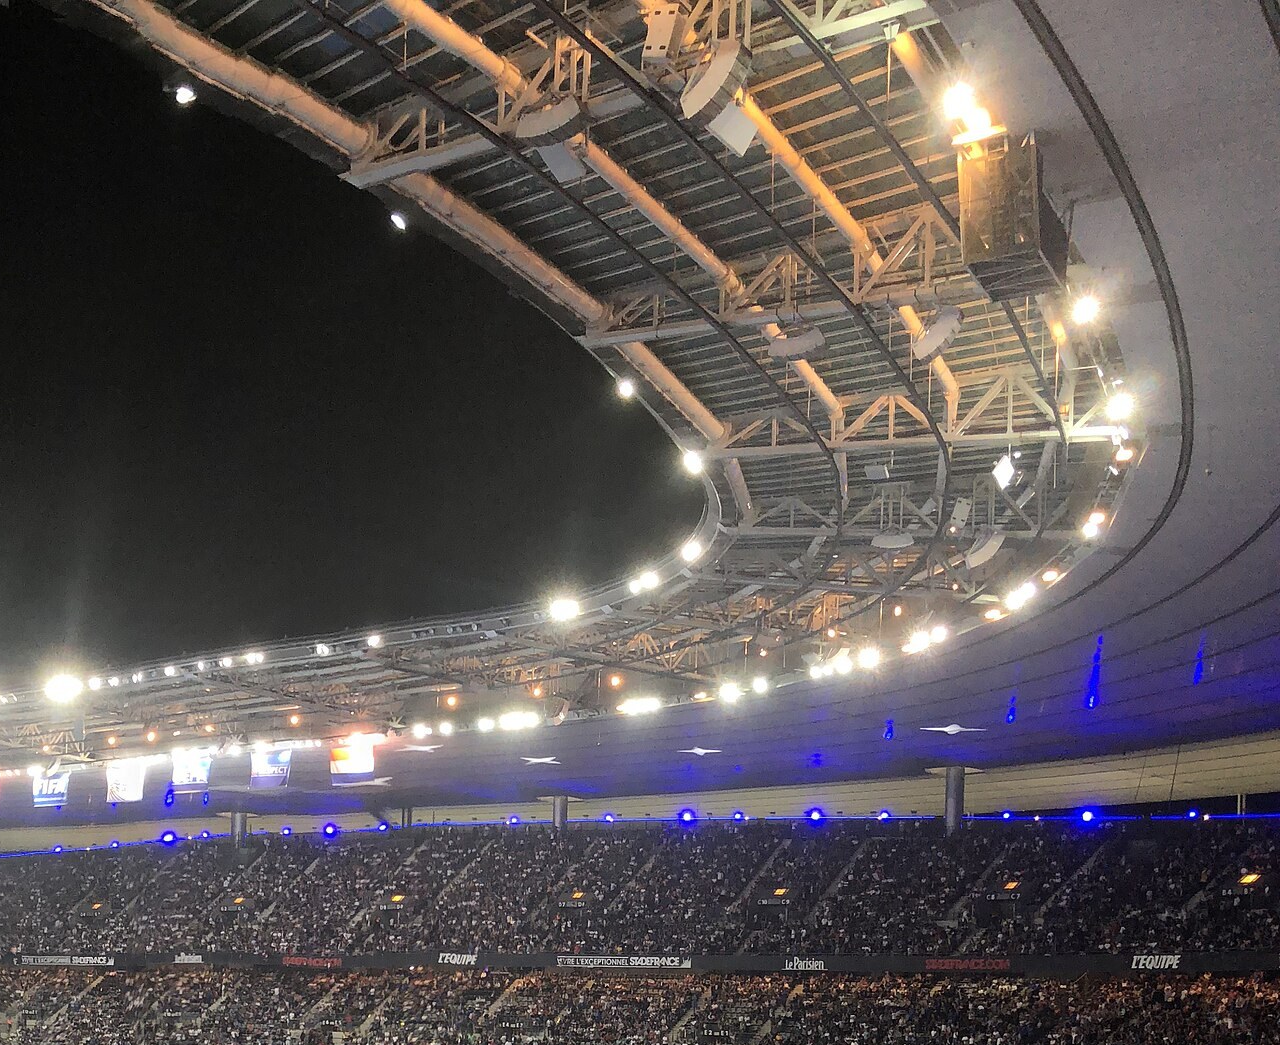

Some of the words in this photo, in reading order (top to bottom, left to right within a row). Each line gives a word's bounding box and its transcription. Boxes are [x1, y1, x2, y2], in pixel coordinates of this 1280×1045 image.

[438, 952, 478, 966] L'EQUIPE
[793, 956, 825, 970] Parisien
[1130, 954, 1181, 969] L'EQUIPE
